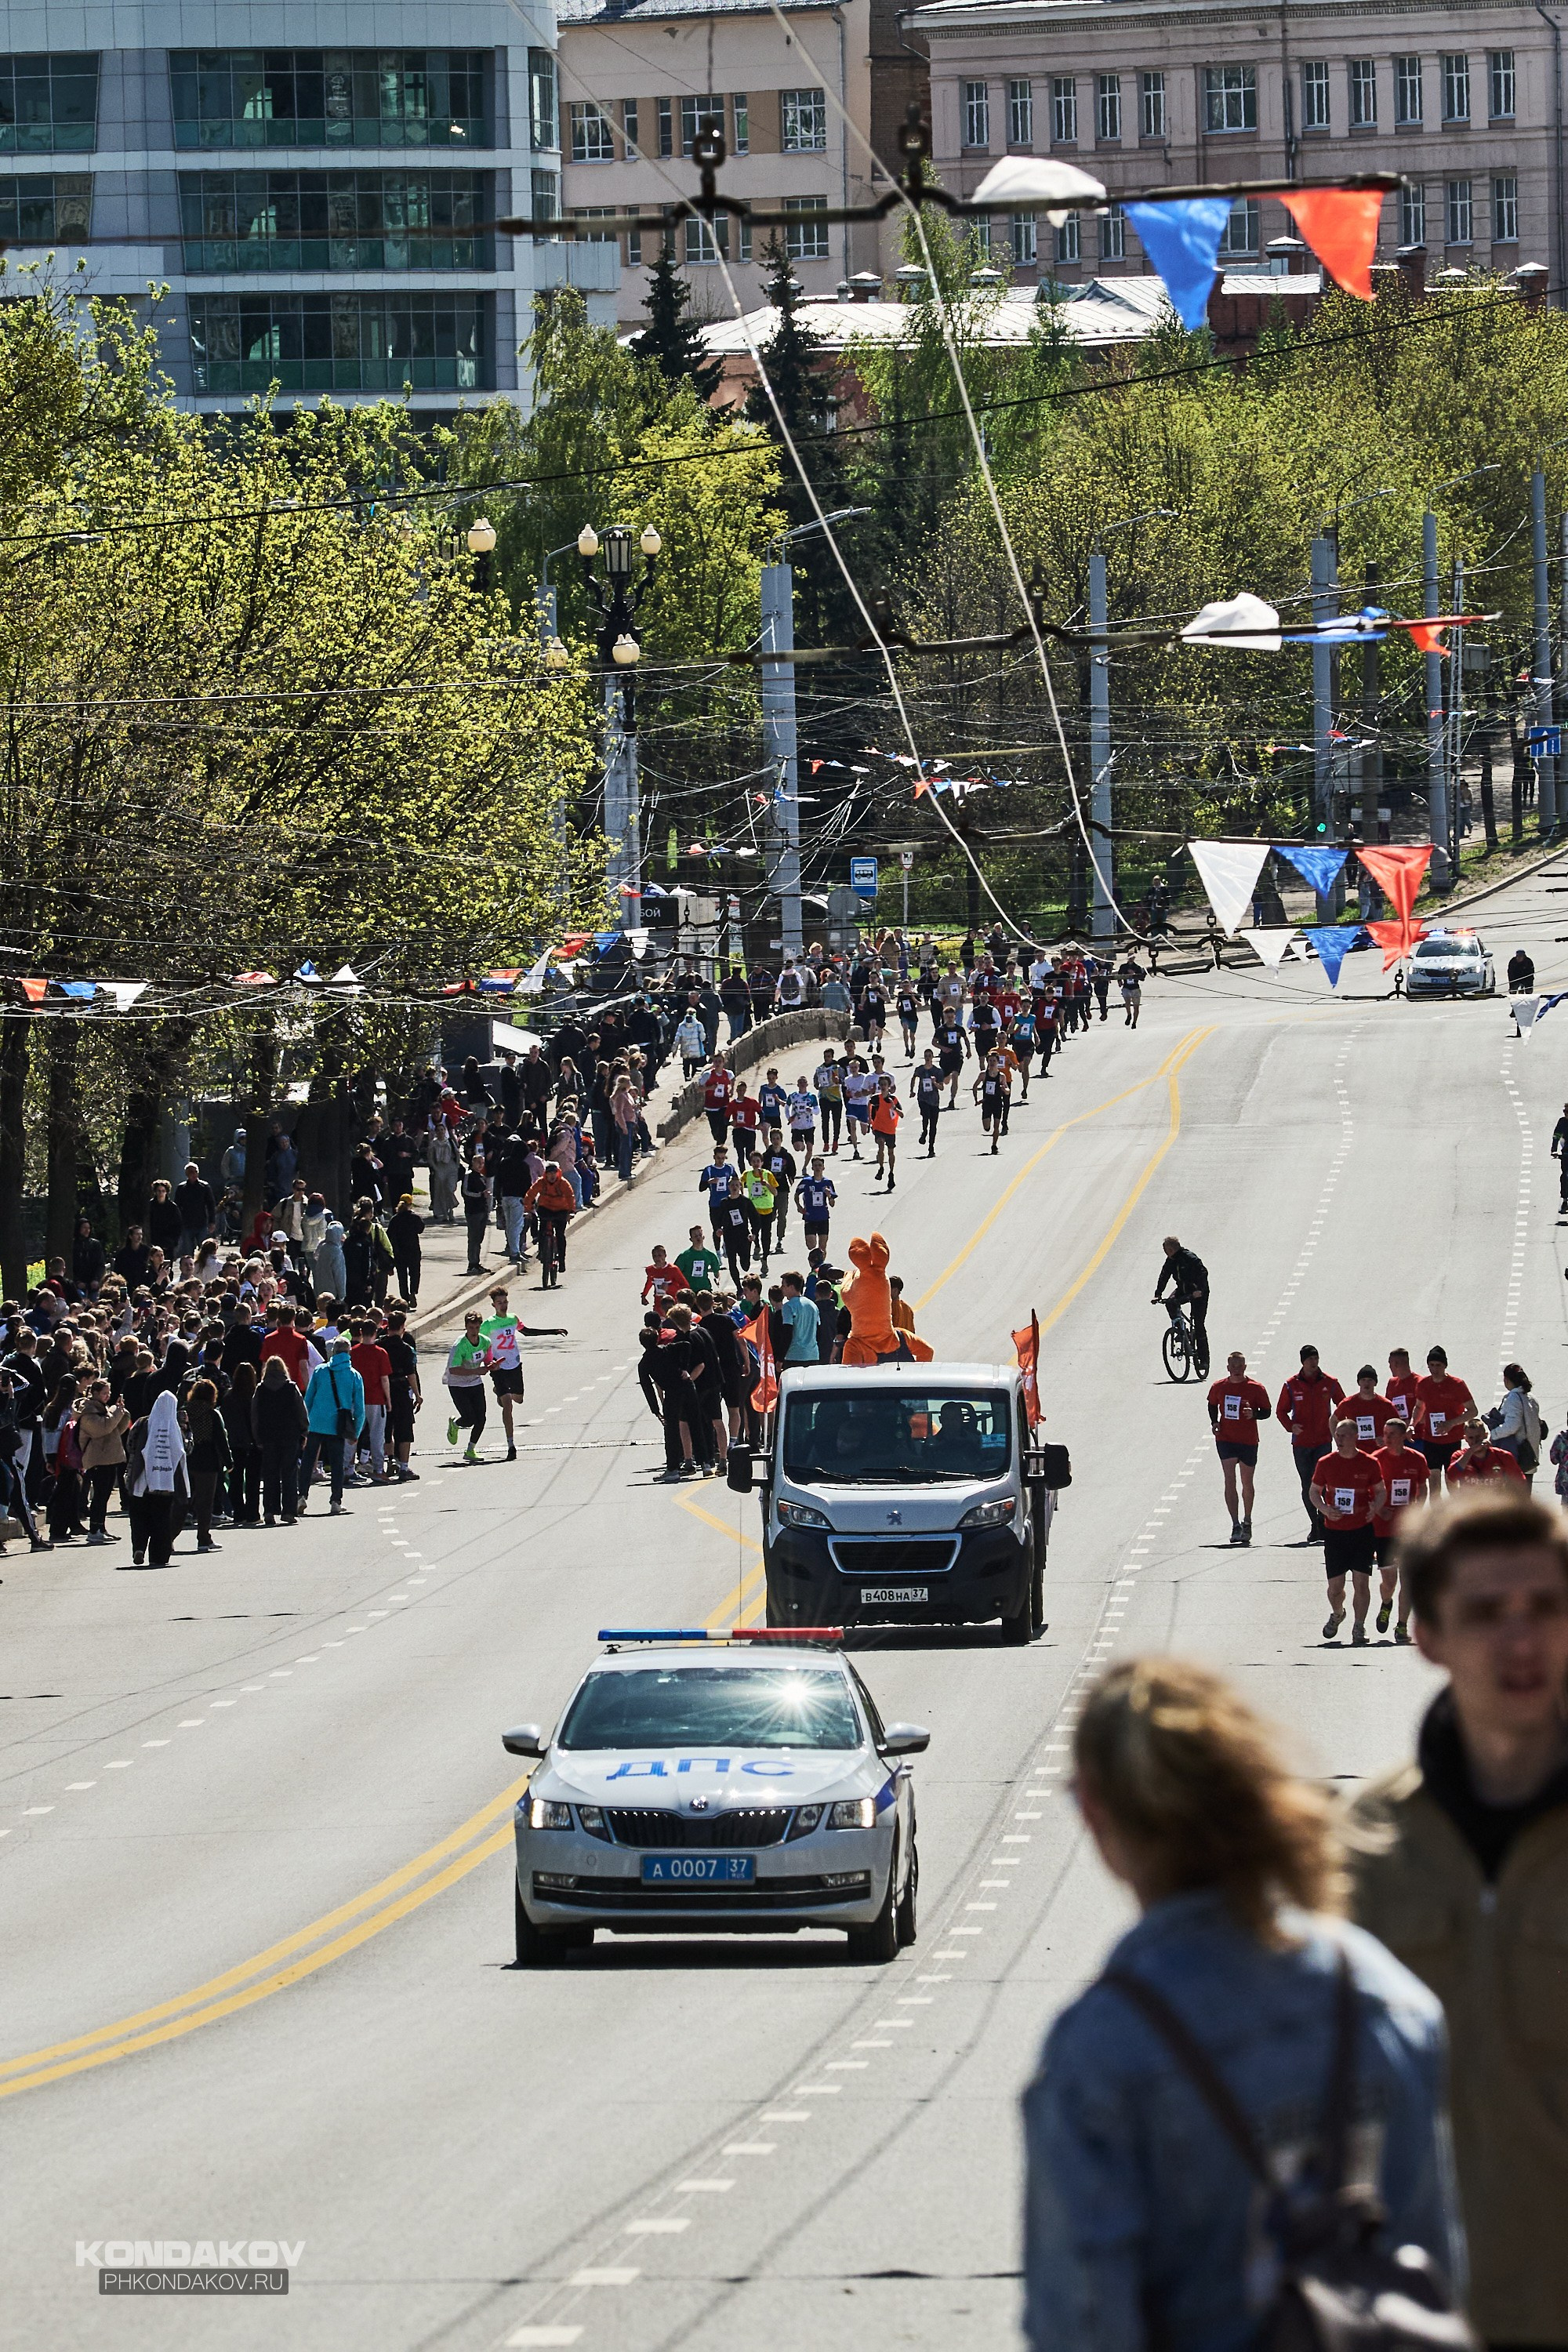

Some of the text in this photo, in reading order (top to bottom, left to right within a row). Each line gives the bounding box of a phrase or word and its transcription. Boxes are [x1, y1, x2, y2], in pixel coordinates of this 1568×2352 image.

[496, 1334, 515, 1350] 22
[1227, 1403, 1238, 1412] 158
[1338, 1497, 1351, 1506] 158
[913, 1588, 924, 1598] 37
[606, 1759, 797, 1781] ДПС
[671, 1860, 717, 1878] 0007
[729, 1859, 747, 1873] 37
